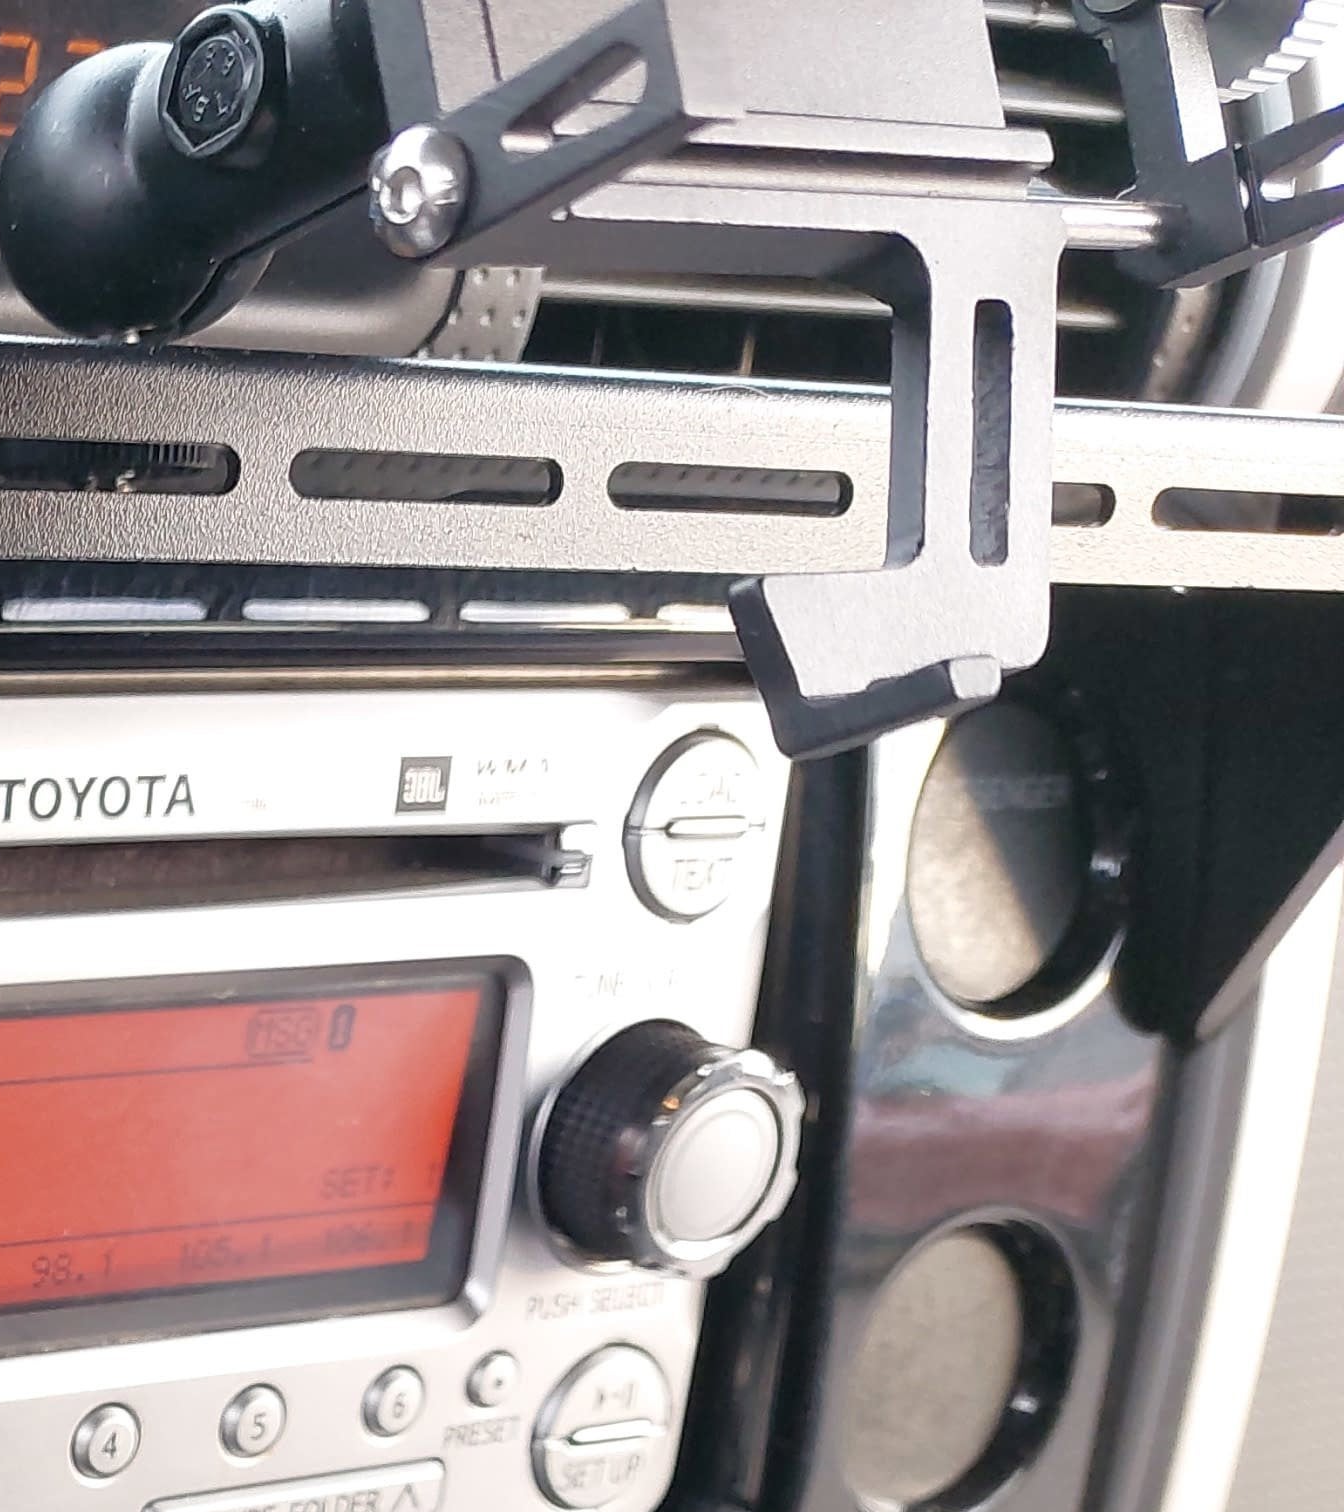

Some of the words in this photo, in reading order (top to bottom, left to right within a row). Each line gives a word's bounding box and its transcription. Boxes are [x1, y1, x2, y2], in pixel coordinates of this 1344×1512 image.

[402, 765, 446, 804] JBL
[31, 1248, 114, 1289] 98.1
[393, 1391, 406, 1417] 6
[251, 1413, 267, 1440] 5
[100, 1432, 118, 1461] 4
